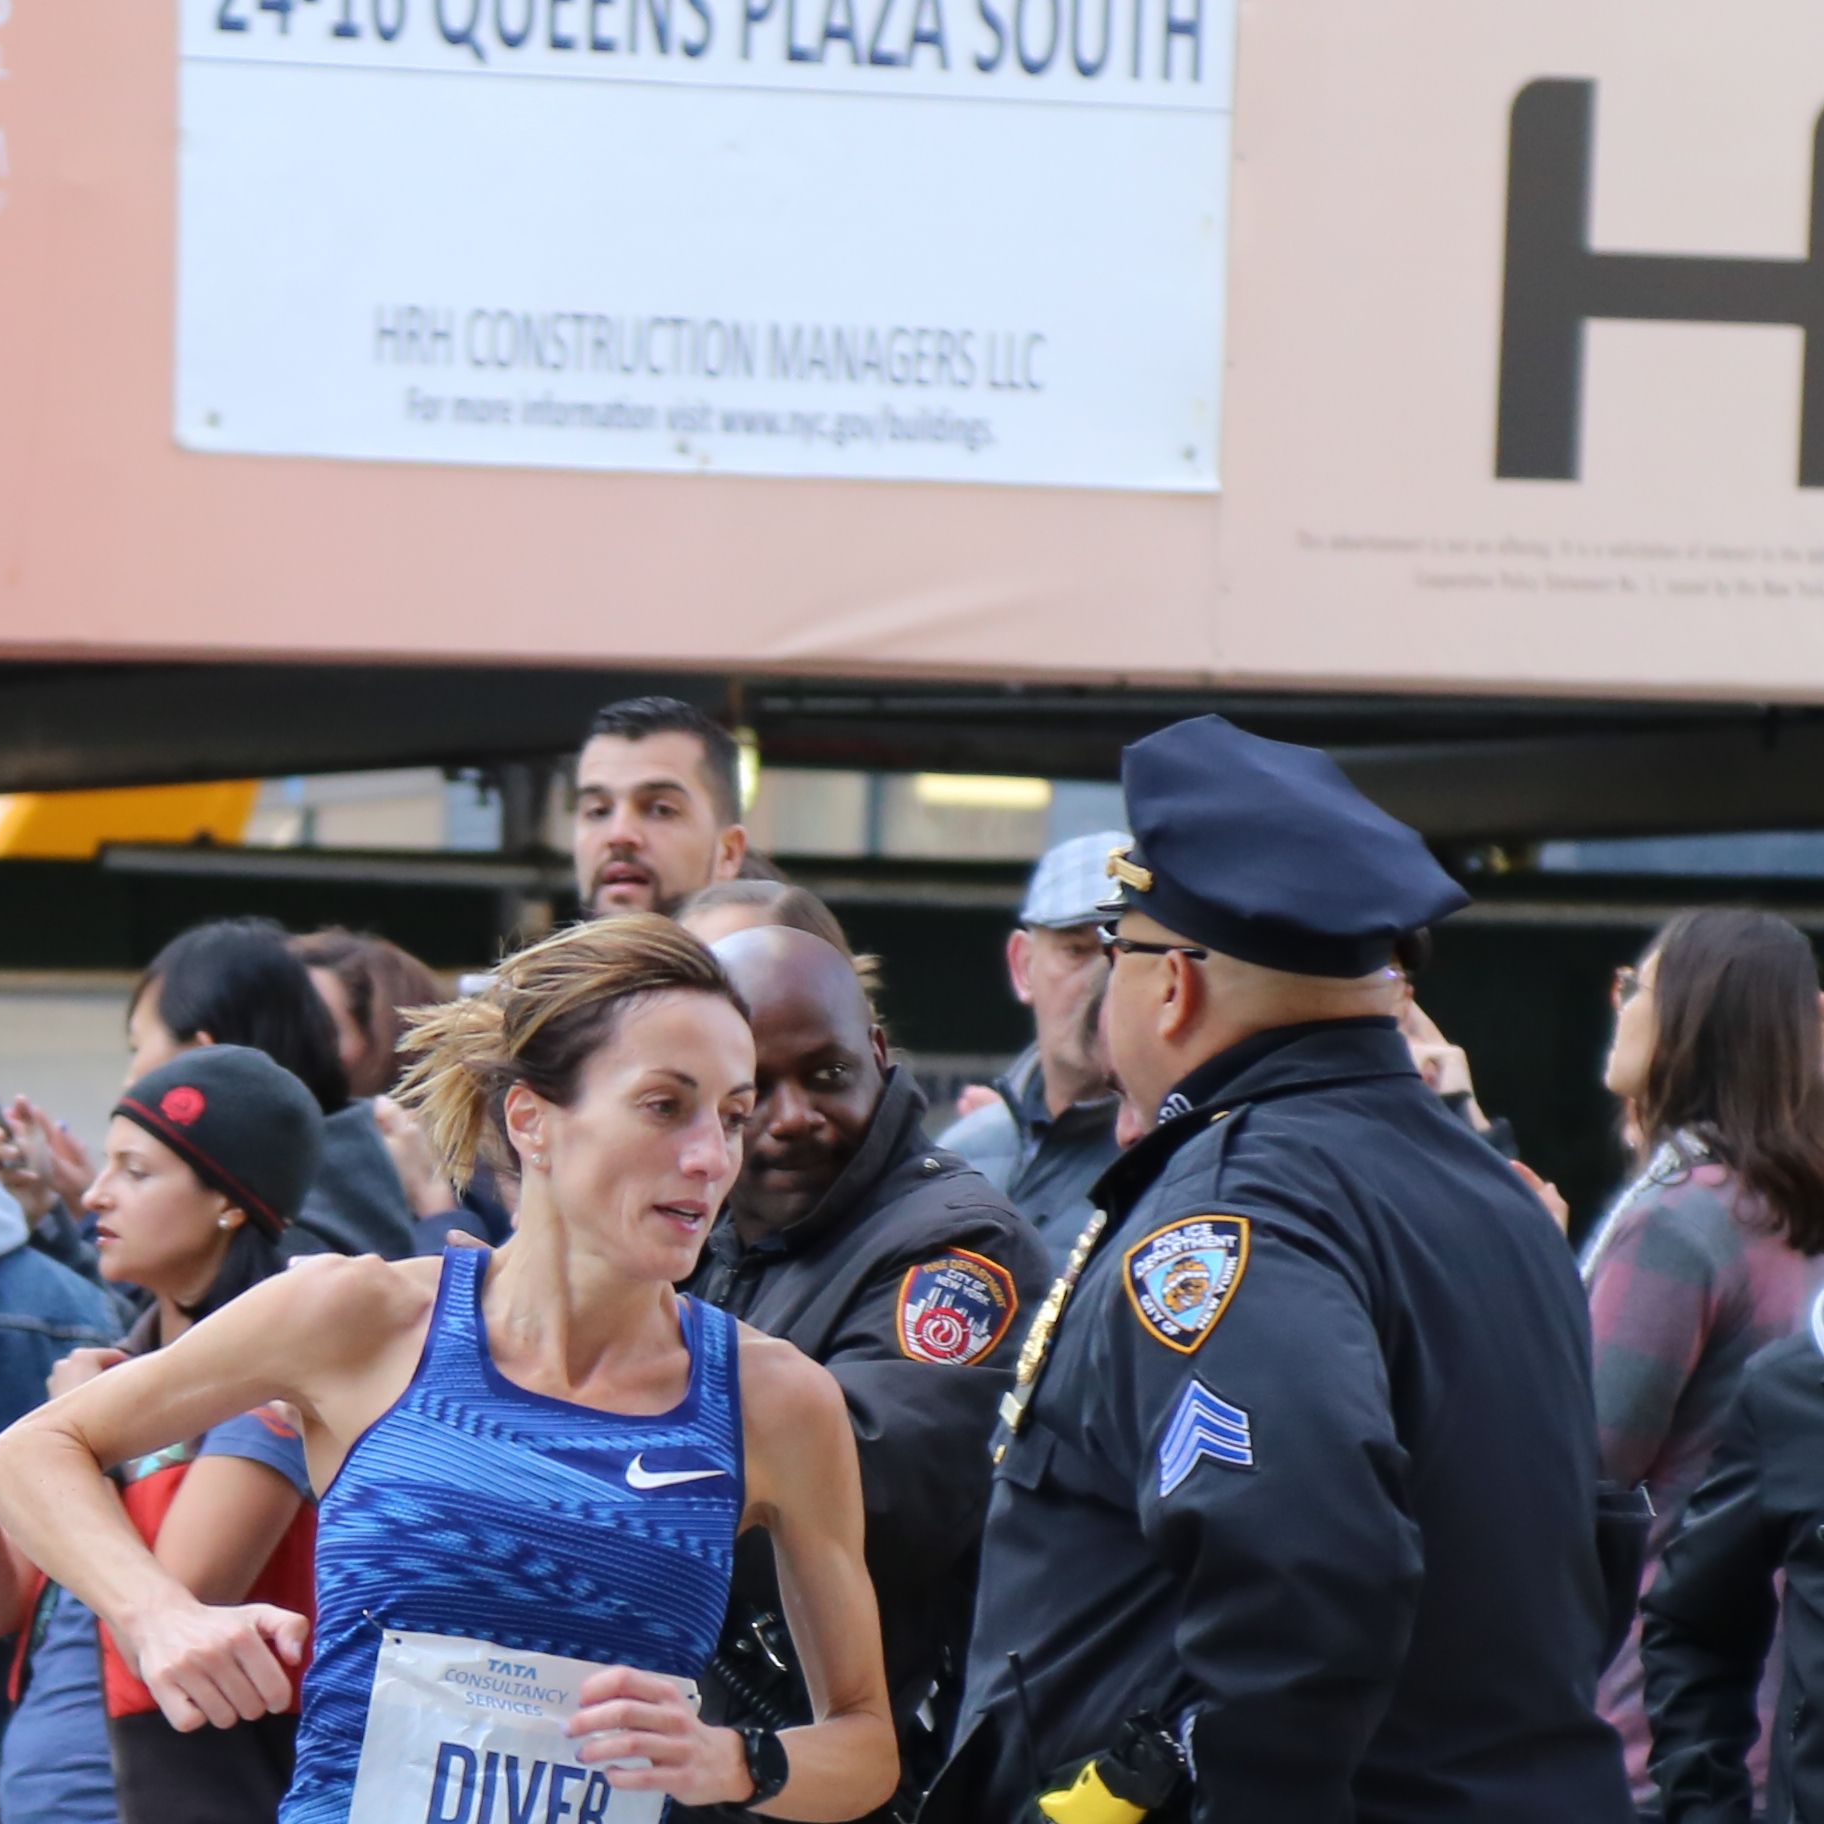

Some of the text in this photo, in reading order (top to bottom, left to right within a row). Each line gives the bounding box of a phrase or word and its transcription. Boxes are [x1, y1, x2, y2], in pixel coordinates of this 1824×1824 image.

[740, 0, 950, 70] PLAZA
[976, 0, 1203, 82] SOUTH
[373, 305, 1047, 393] HRH CONSTRUCTION MANAGERS LLC
[404, 386, 446, 420] For
[452, 395, 514, 425] more
[520, 391, 660, 432] information
[666, 398, 711, 434] visit
[1152, 1222, 1214, 1251] POLICE
[922, 1259, 948, 1274] FIRE
[1133, 1234, 1239, 1280] DEPARTMENT
[934, 1273, 991, 1307] NEW YORK
[946, 1268, 973, 1285] CITY
[1196, 1255, 1240, 1330] NEW YORK
[1140, 1294, 1181, 1336] CITY OF
[444, 1667, 569, 1705] CONSULTANCY
[487, 1657, 538, 1681] TATA
[464, 1690, 544, 1718] SERVICES
